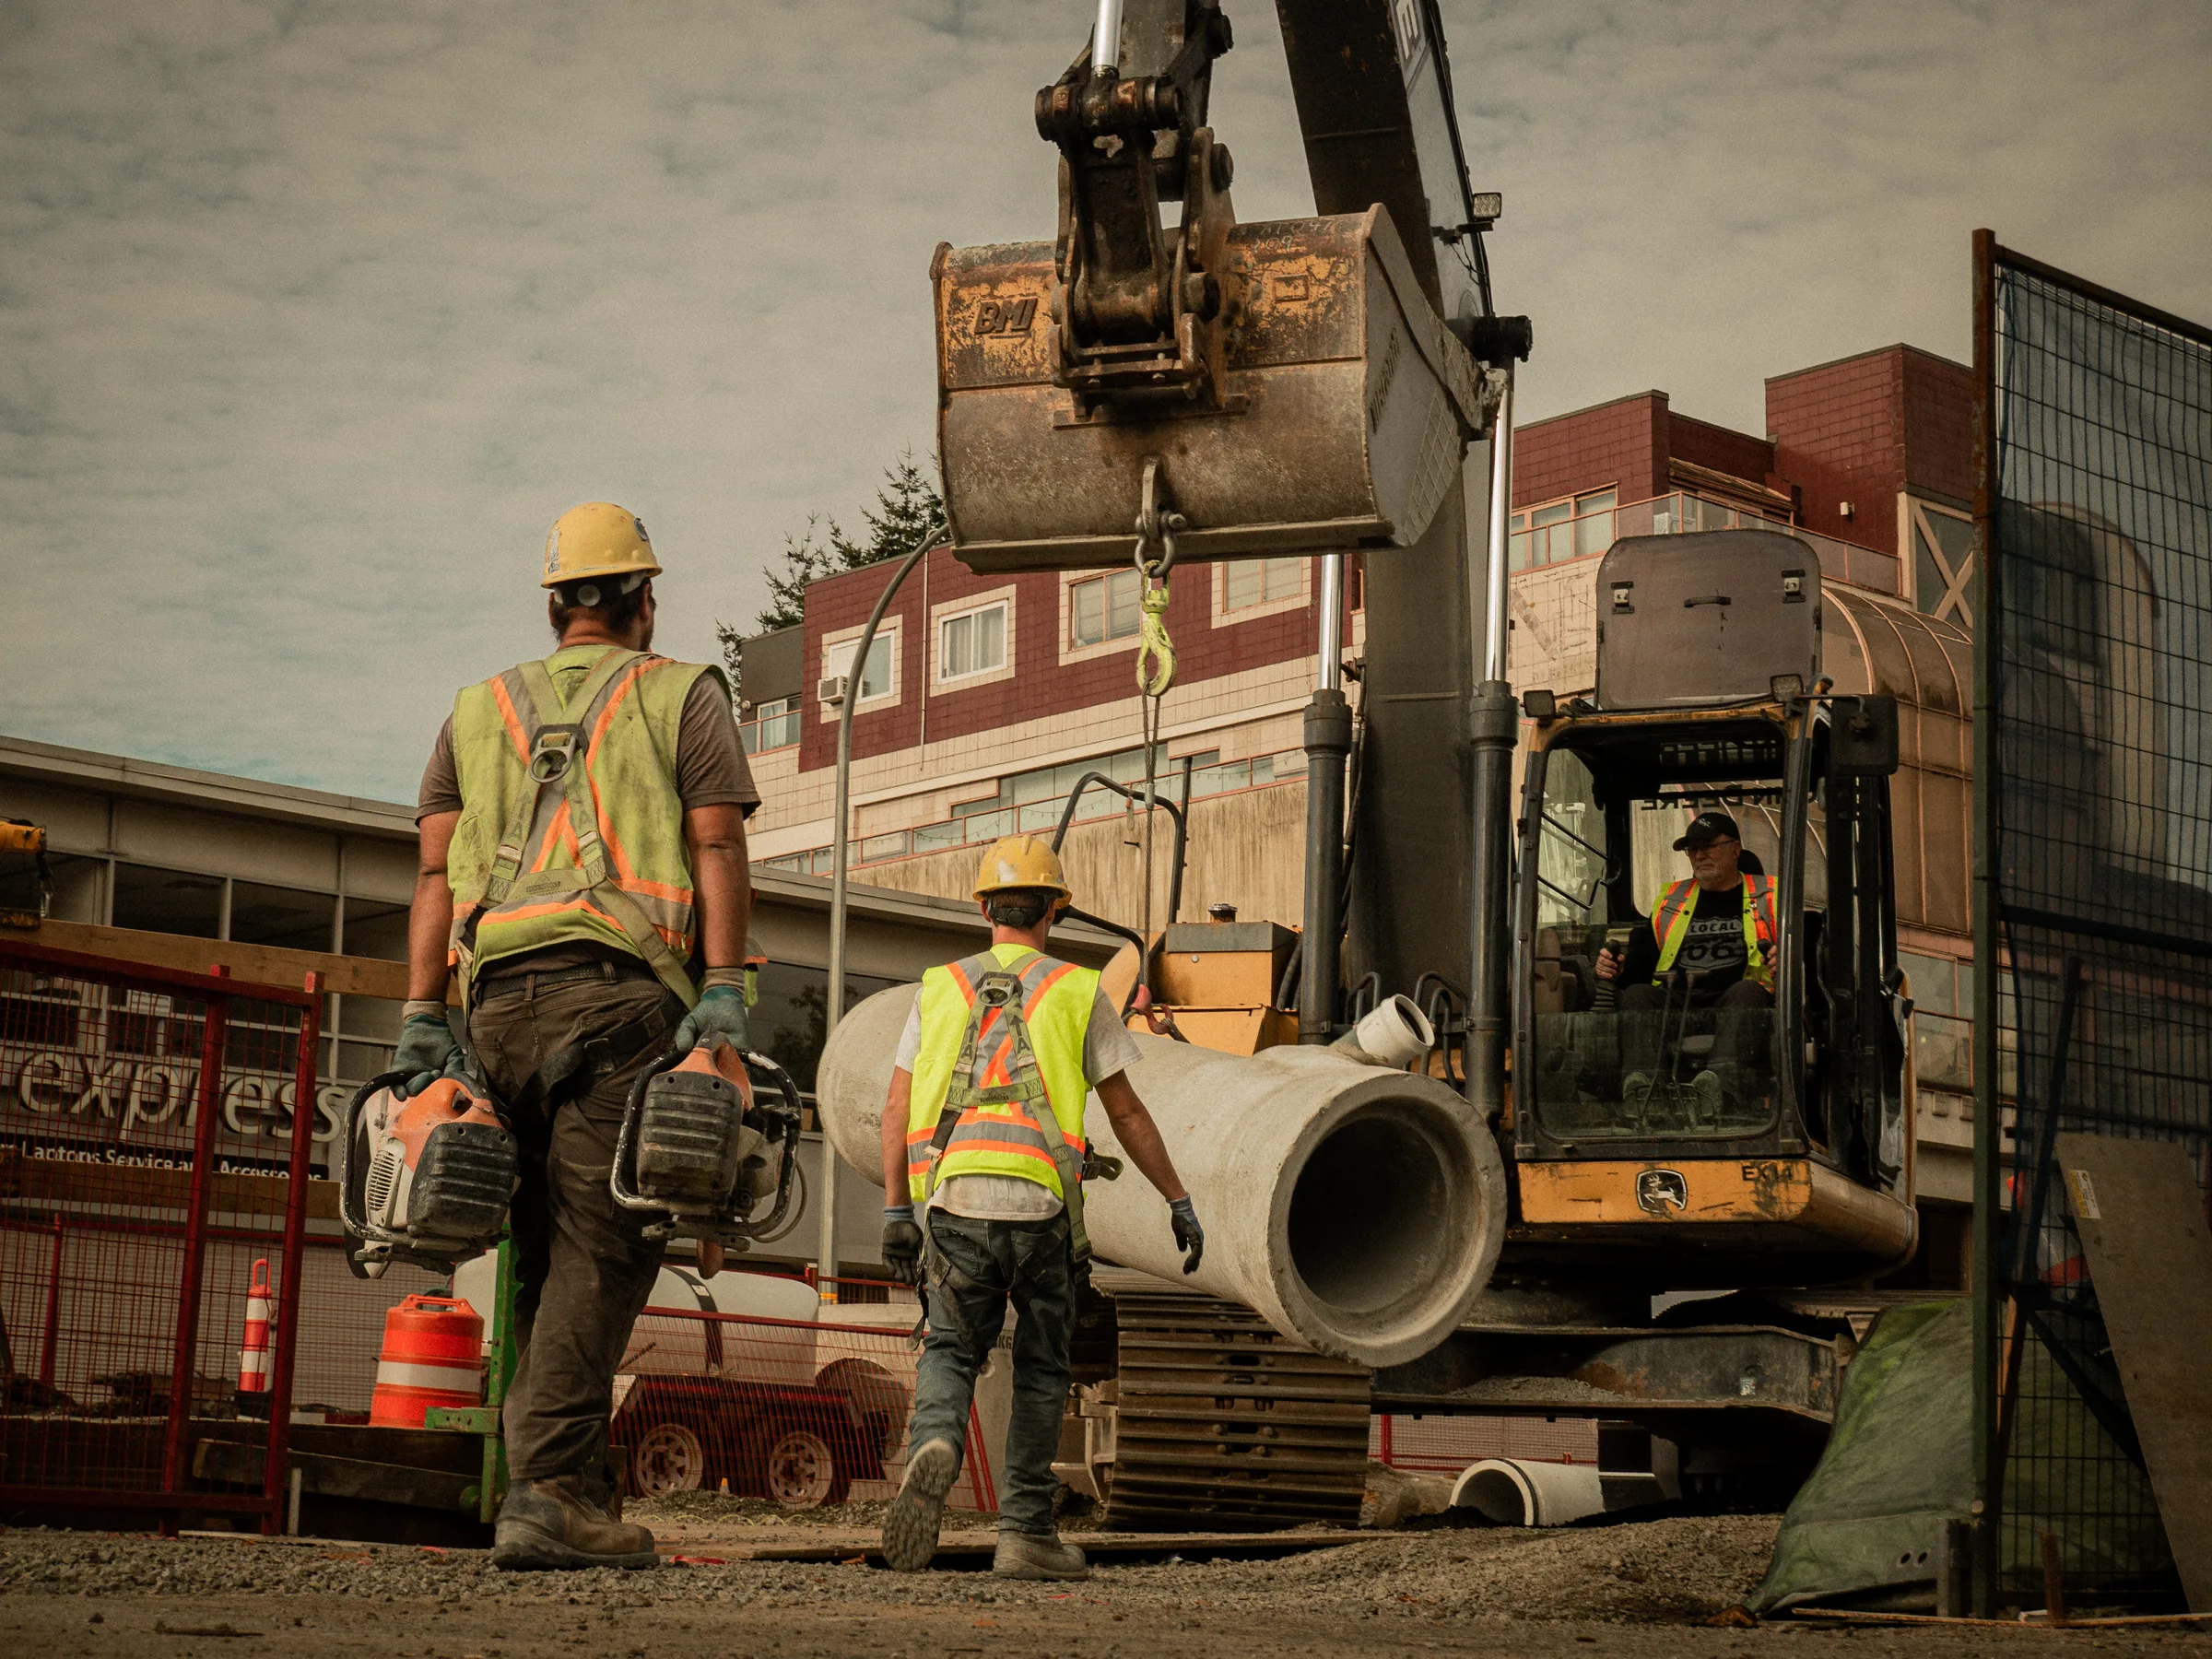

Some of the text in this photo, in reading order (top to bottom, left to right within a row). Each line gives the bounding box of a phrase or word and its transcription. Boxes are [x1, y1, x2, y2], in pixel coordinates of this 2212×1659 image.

[974, 296, 1039, 335] BMI
[1689, 923, 1737, 933] LOCAL
[18, 1050, 348, 1143] express
[106, 1148, 173, 1170] Service
